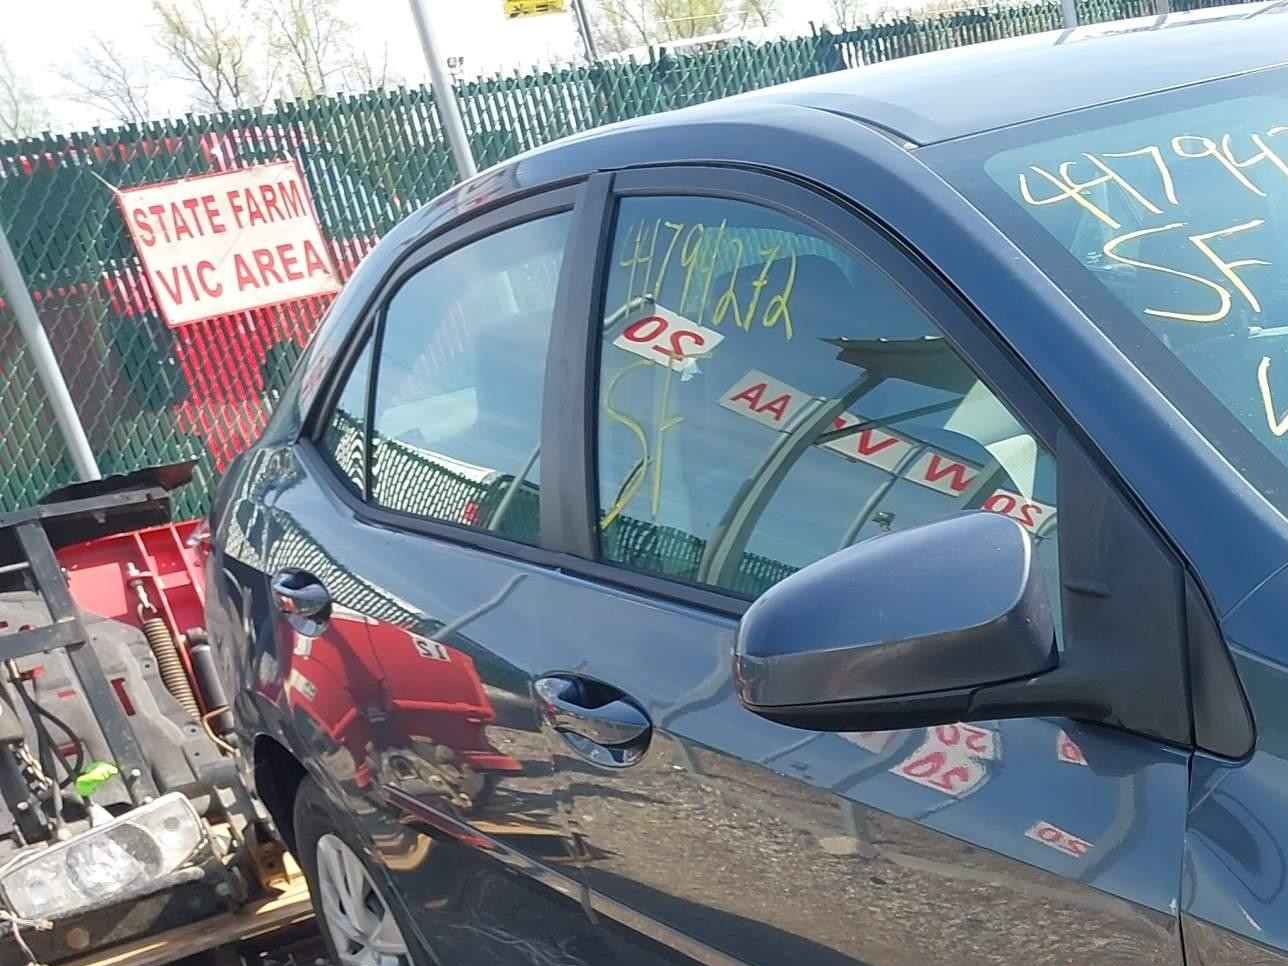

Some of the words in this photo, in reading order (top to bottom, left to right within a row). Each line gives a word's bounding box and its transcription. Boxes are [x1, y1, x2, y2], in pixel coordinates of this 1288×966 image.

[132, 194, 227, 248] STATE
[226, 179, 308, 230] FARM
[154, 259, 224, 306] VIC
[232, 239, 331, 293] AREA
[1102, 219, 1273, 322] SF
